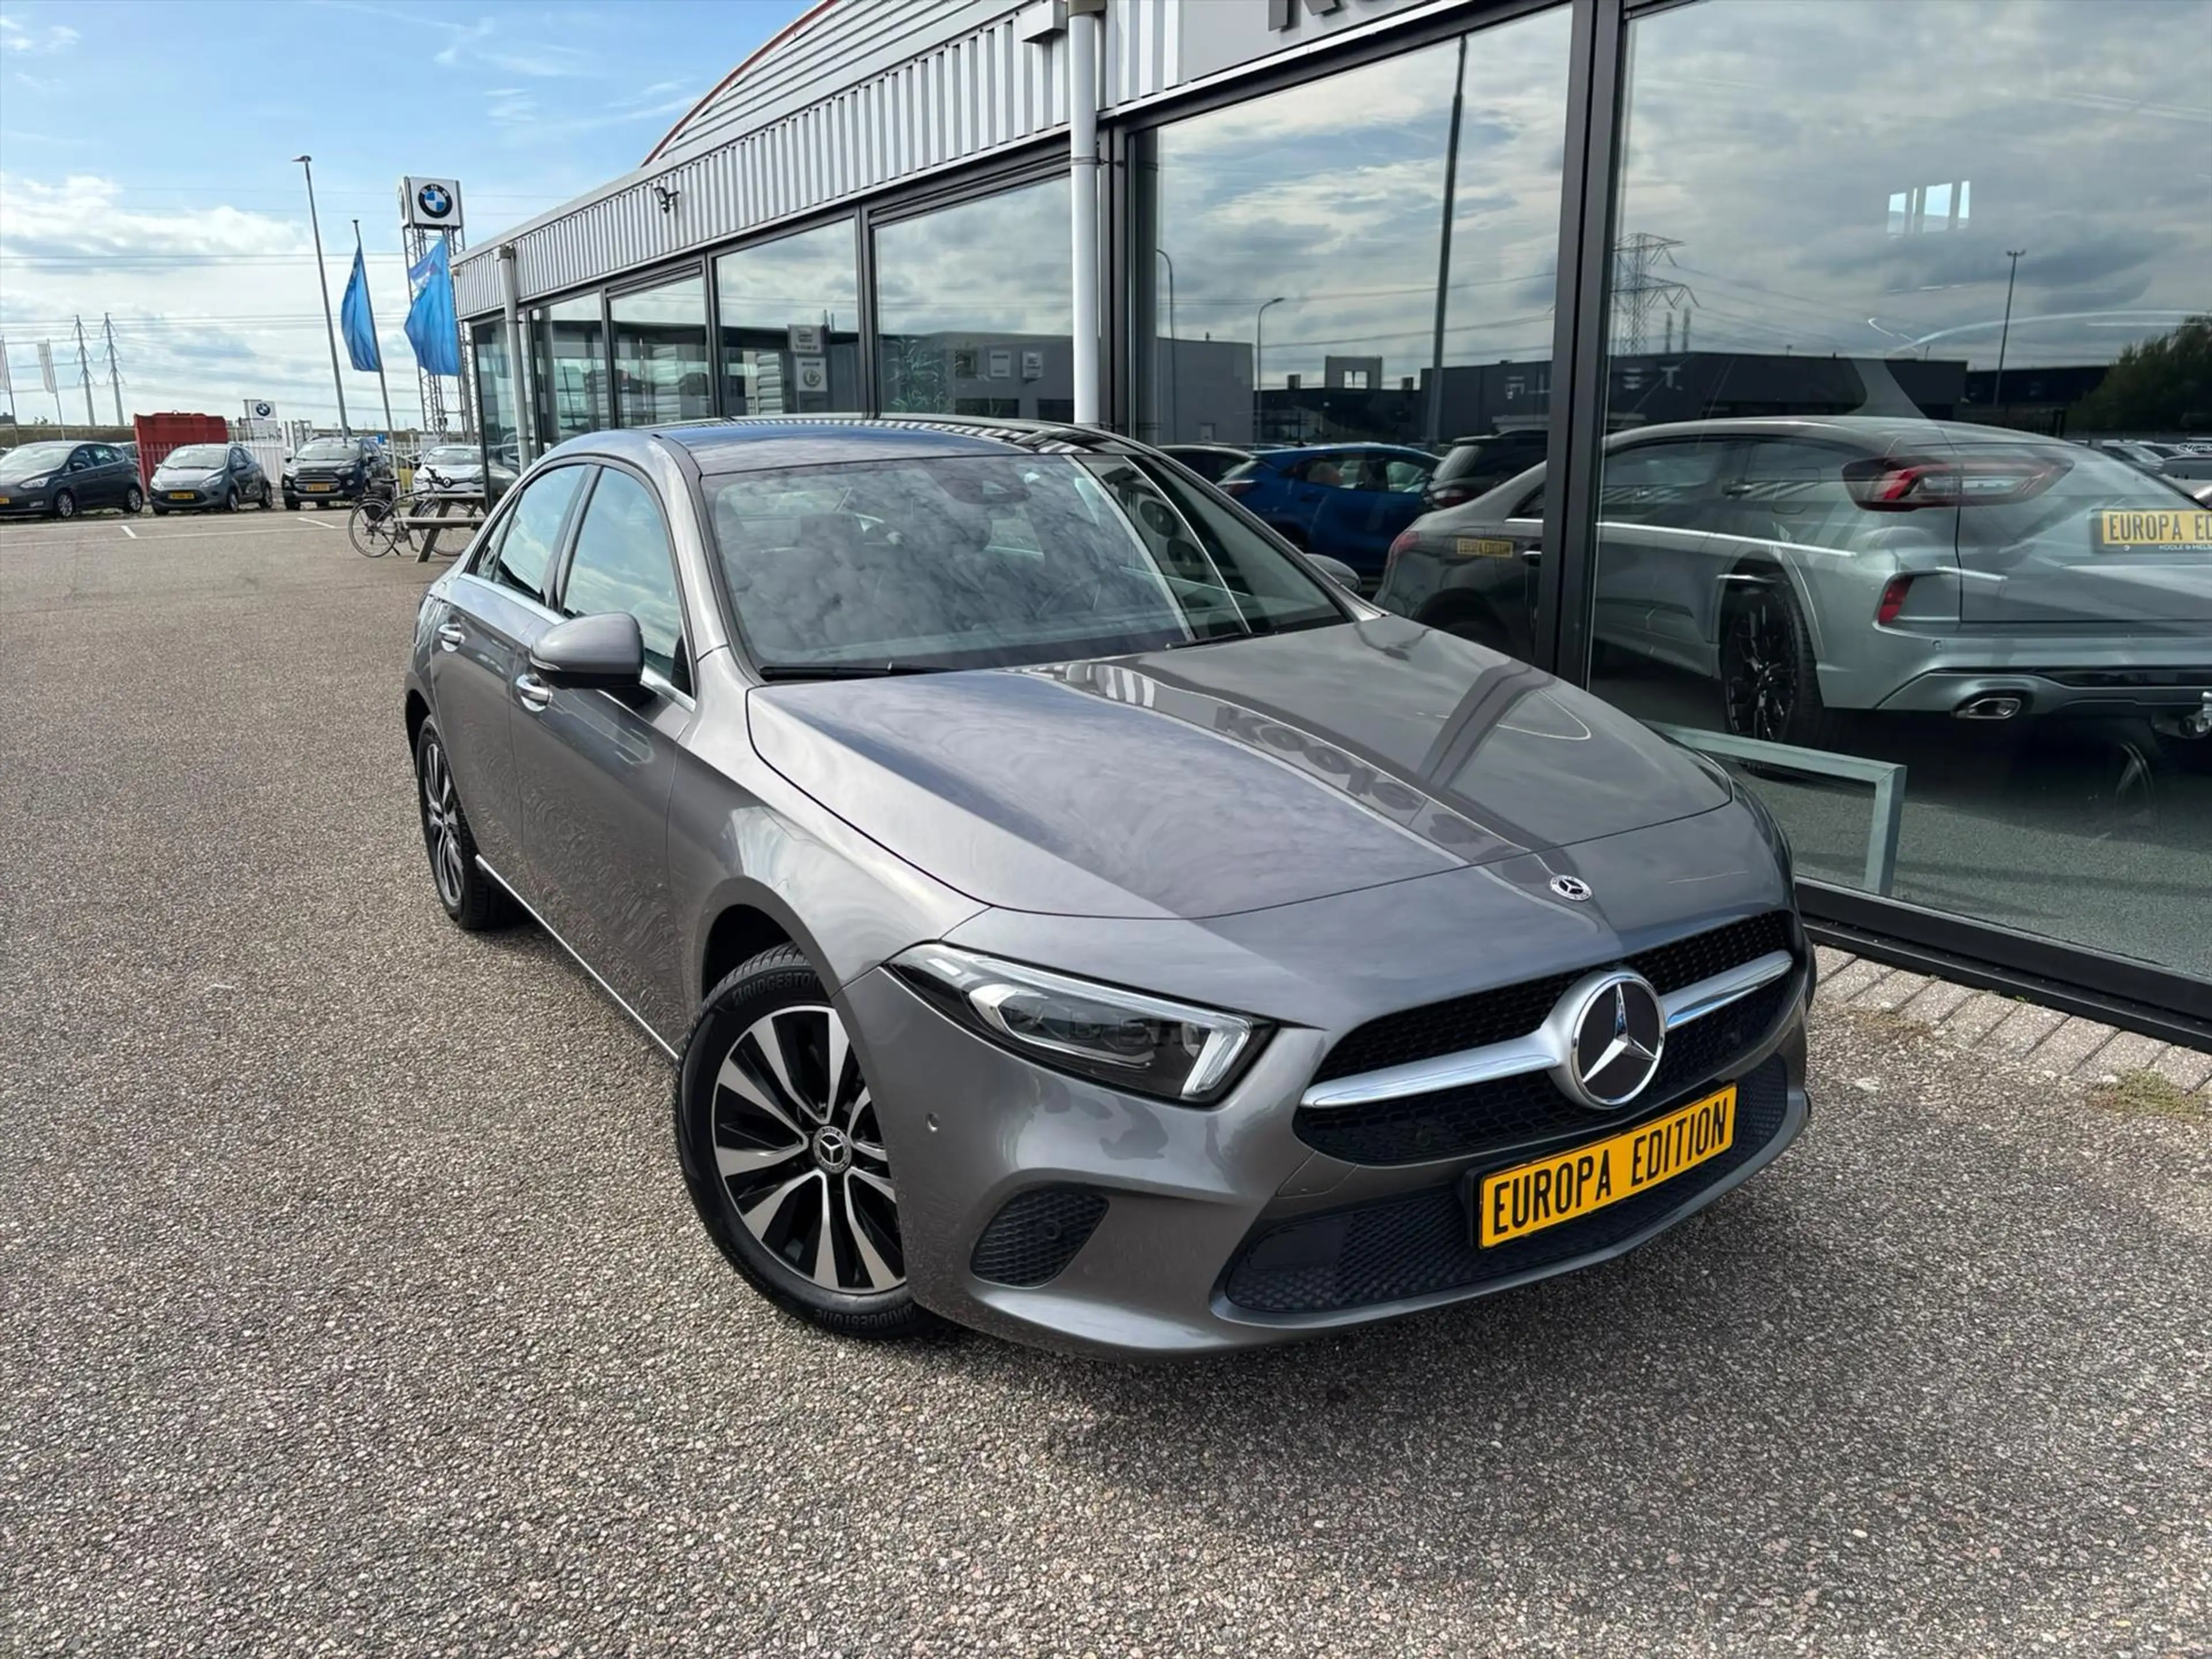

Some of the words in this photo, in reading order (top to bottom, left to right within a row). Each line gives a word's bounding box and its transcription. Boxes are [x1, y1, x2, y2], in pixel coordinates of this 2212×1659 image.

[2109, 513, 2183, 540] EUROPA
[1493, 1149, 1612, 1237] EUROPA
[1630, 1096, 1728, 1187] EDITION
